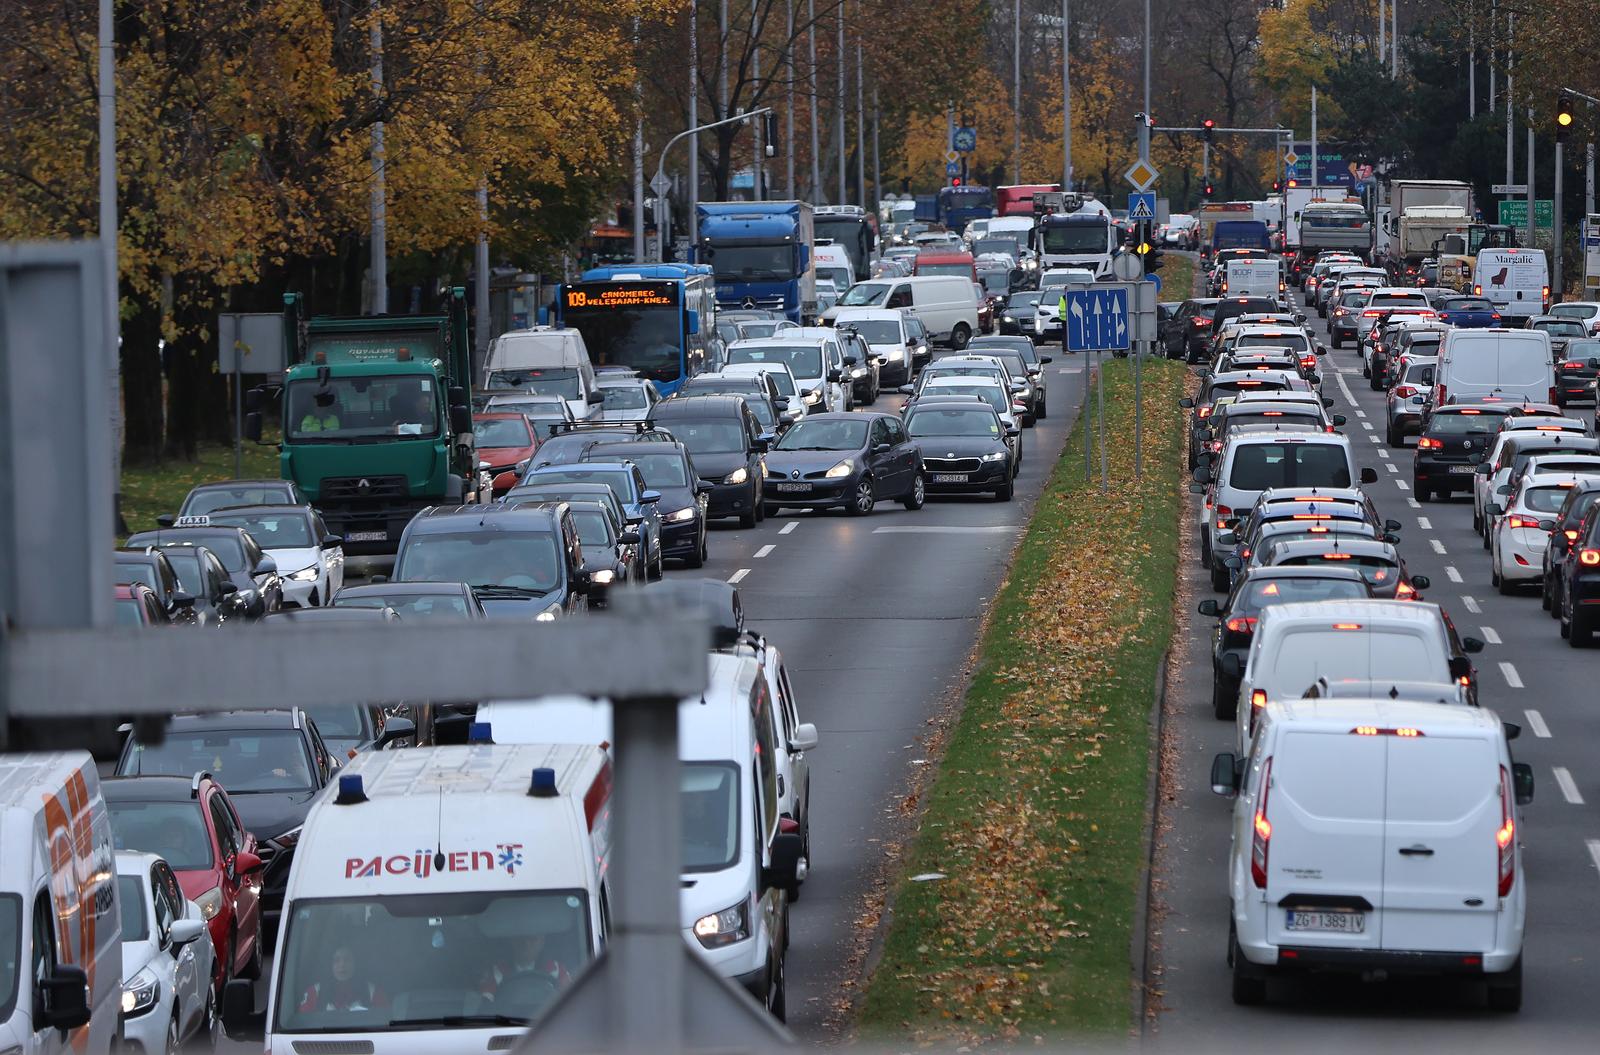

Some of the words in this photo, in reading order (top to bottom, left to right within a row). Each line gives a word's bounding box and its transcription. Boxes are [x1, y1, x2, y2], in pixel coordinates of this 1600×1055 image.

[1495, 255, 1533, 264] Margalić
[568, 291, 586, 307] 109
[180, 516, 208, 525] TAXI
[1295, 913, 1310, 927] ZG
